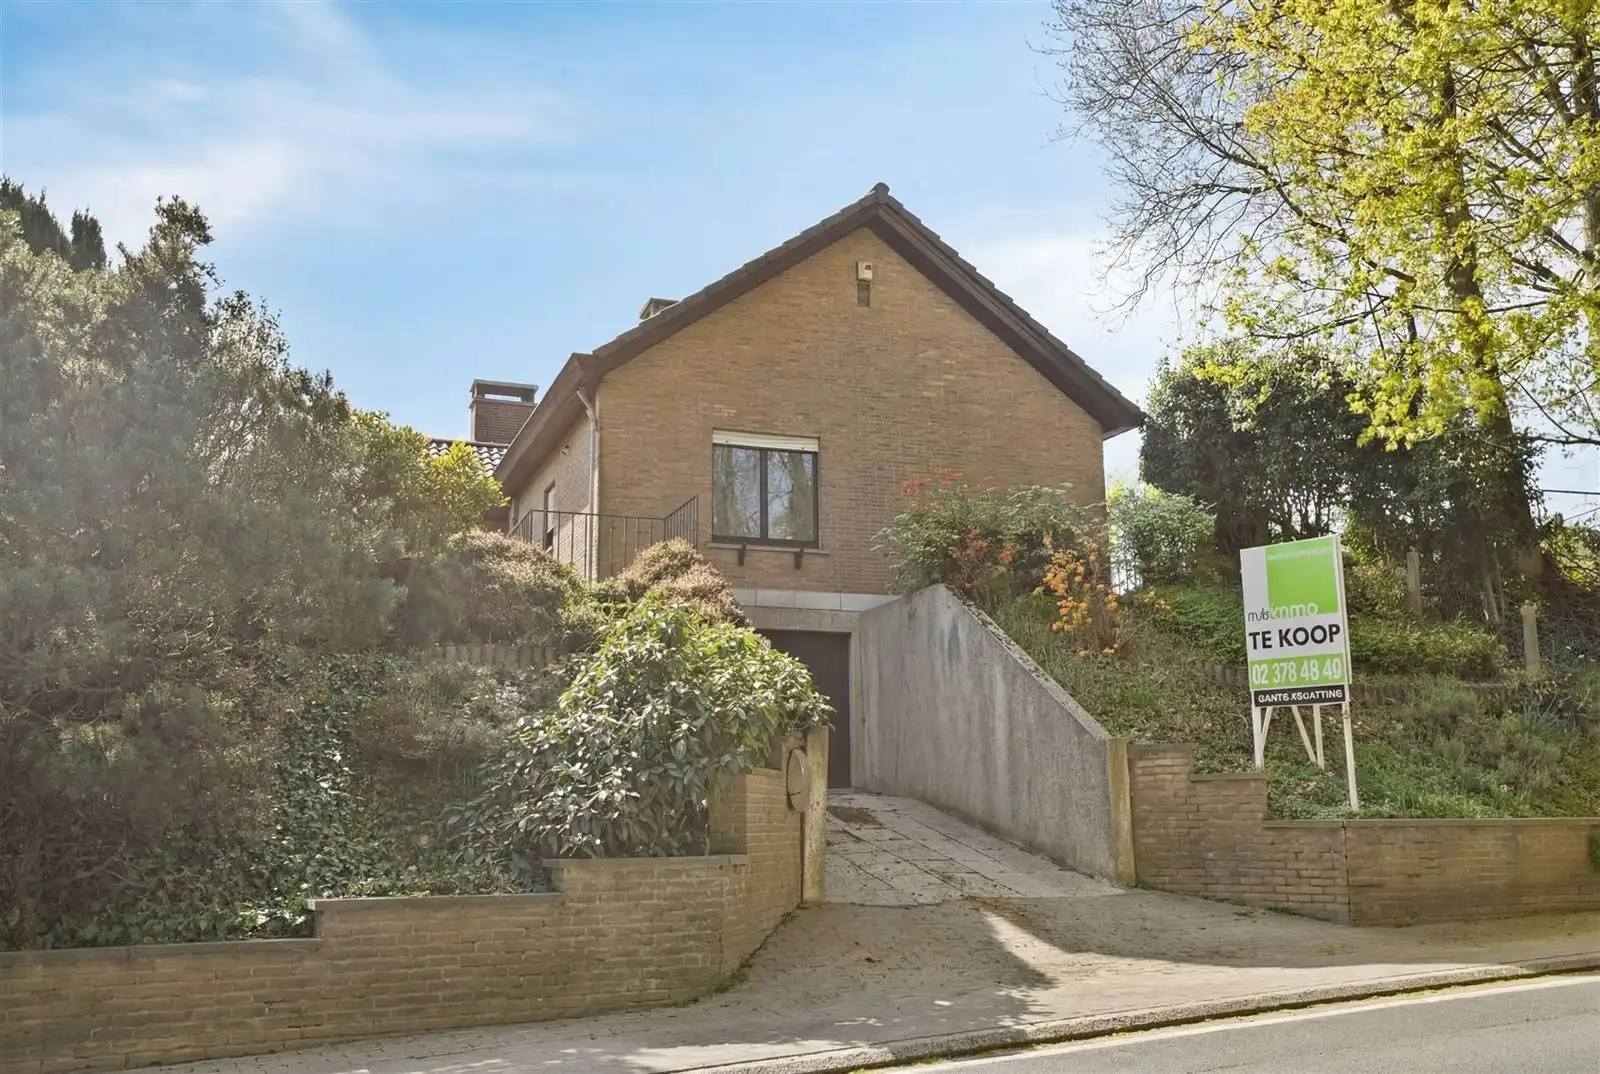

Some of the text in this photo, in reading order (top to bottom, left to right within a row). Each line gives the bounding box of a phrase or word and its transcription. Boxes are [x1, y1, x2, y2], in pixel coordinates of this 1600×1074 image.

[1248, 623, 1341, 650] TE KOOP
[1252, 657, 1342, 685] 02 378 48 49
